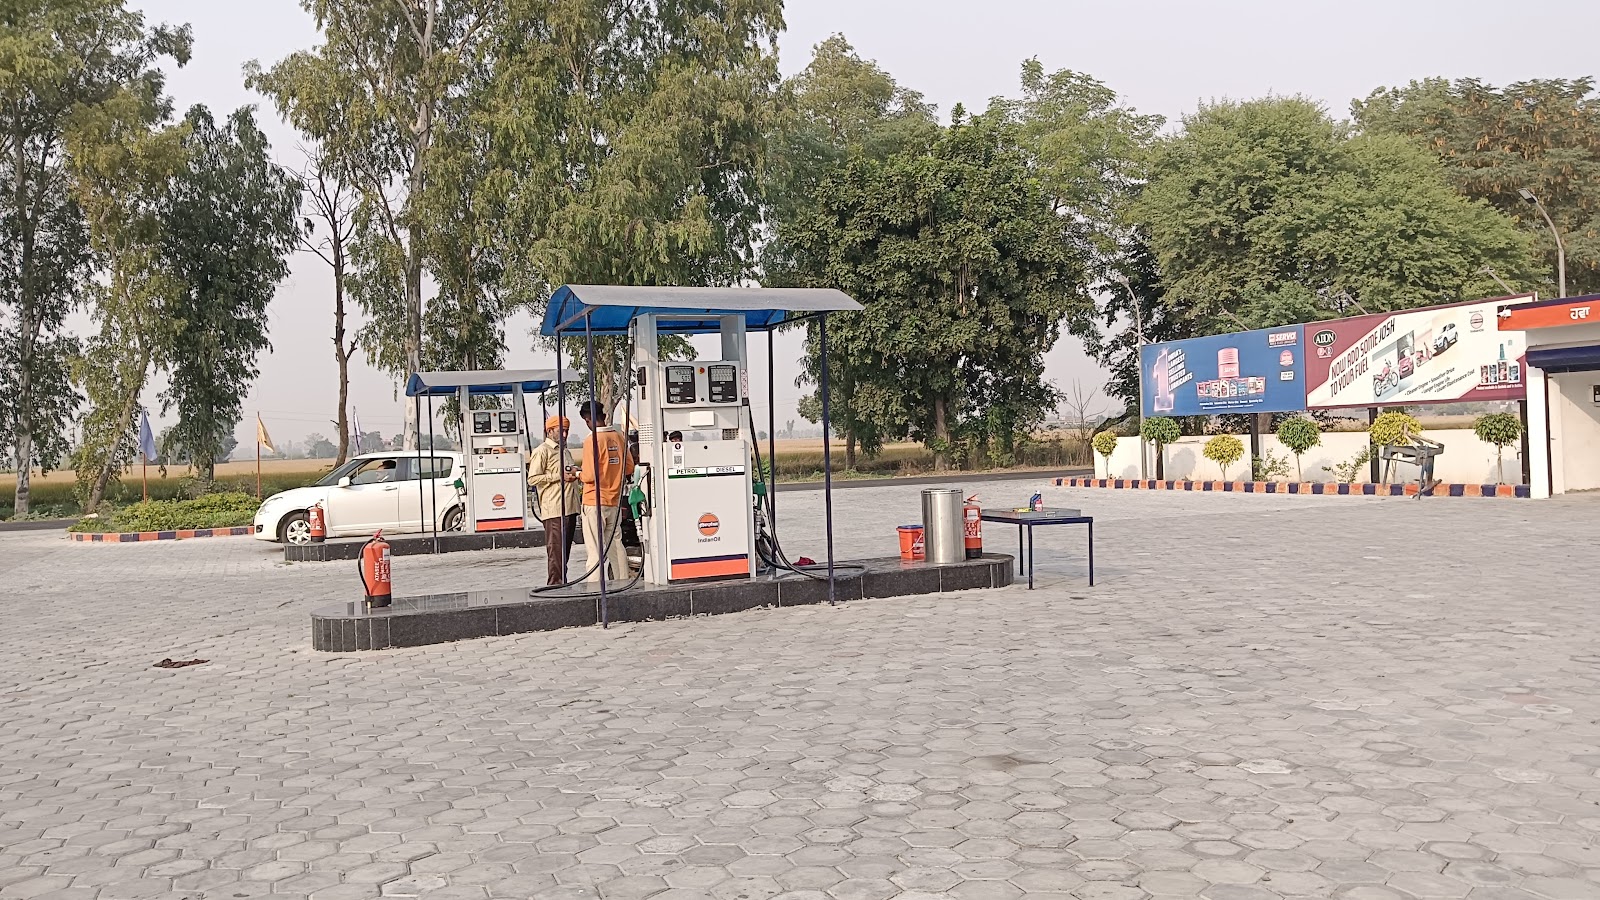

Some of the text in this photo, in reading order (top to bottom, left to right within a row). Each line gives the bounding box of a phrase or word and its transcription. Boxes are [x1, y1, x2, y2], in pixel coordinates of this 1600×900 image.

[1570, 307, 1590, 319] ਹਵਾ
[1331, 318, 1396, 380] NOW ADD SOME JOSH
[1330, 356, 1369, 397] TO YOUR FUEL
